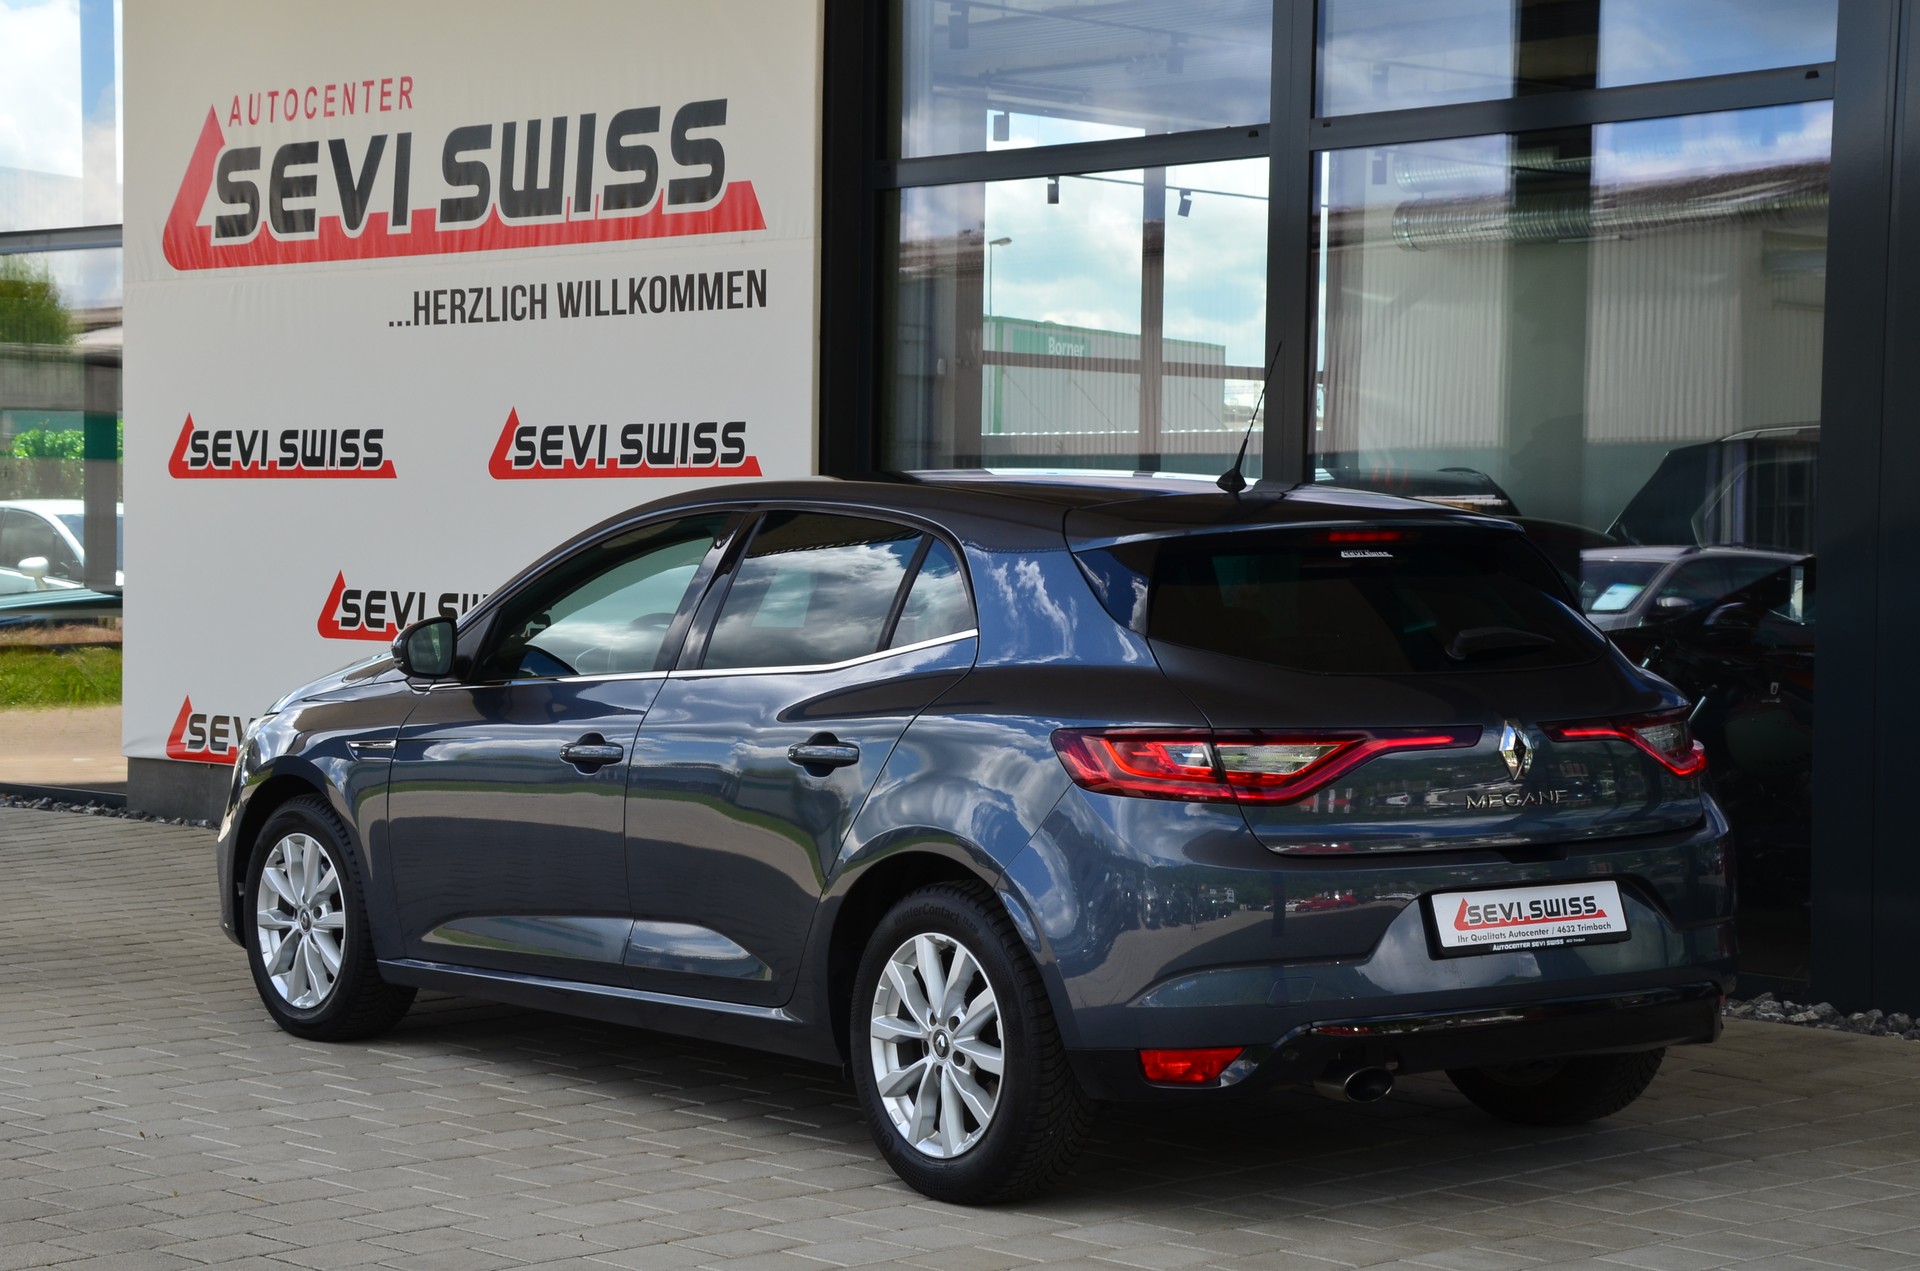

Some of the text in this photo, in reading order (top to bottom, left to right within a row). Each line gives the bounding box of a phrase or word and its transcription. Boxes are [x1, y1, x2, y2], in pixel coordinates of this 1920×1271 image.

[228, 75, 414, 127] AUTOCENTER
[214, 98, 728, 239] SEVI SWISS
[388, 268, 767, 328] ...HERZLICH WILLKOMMEN
[1048, 336, 1085, 357] Borner
[189, 428, 384, 468] SEVI SWISS
[513, 421, 747, 467] SEVI SWISS
[340, 589, 426, 630] SEVI
[187, 713, 257, 752] SEV
[1466, 789, 1568, 810] MEGANE
[1467, 895, 1597, 925] SEVI SWISS
[1457, 934, 1469, 943] Ihr
[1508, 928, 1550, 939] Autocenter
[1557, 925, 1576, 934] 4632
[1577, 922, 1612, 932] Trimbach
